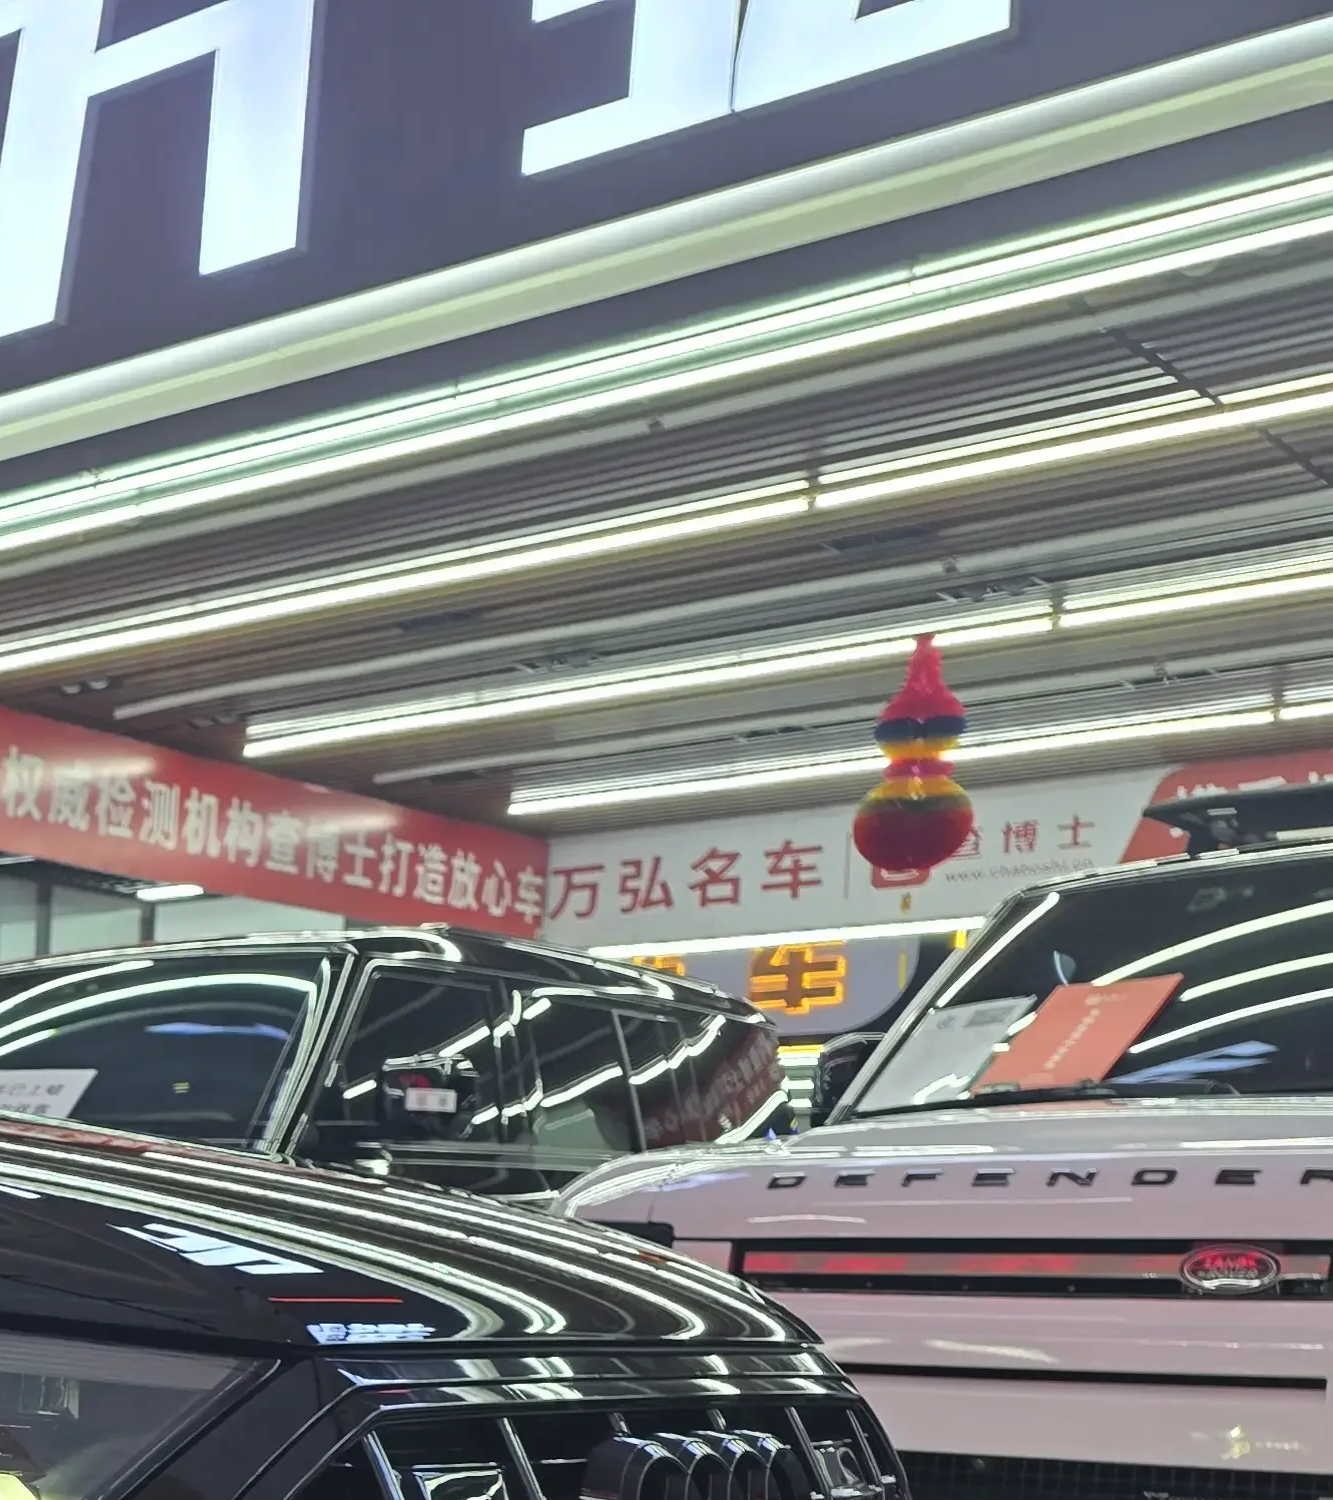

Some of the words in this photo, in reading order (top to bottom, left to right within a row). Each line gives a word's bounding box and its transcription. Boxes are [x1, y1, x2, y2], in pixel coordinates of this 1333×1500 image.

[547, 838, 823, 921] 万弘名车
[766, 1166, 1333, 1188] DEFENDER
